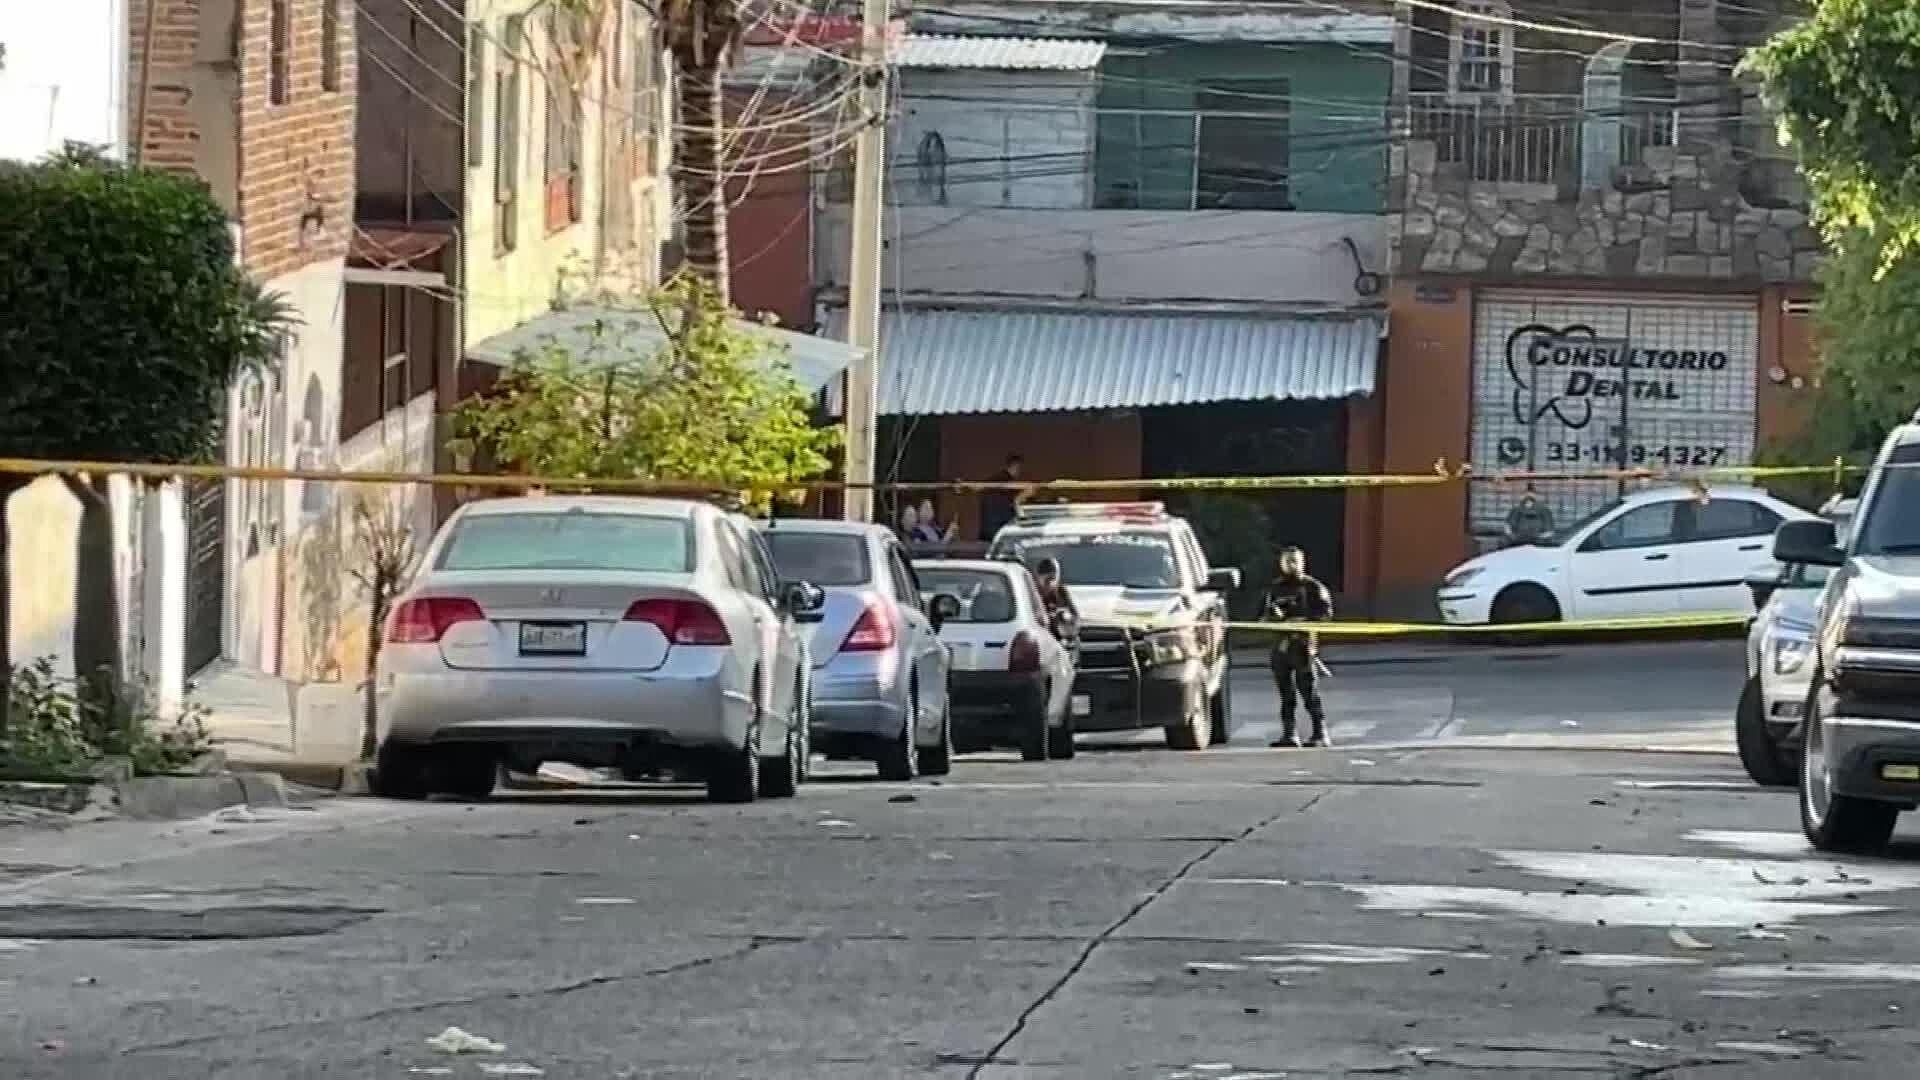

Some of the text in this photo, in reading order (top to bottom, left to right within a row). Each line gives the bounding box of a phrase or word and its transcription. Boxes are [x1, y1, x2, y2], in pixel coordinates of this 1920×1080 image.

[1528, 341, 1727, 370] CONSULTORIO
[1566, 371, 1681, 400] DENTAL
[1547, 442, 1726, 466] 33-119-4327
